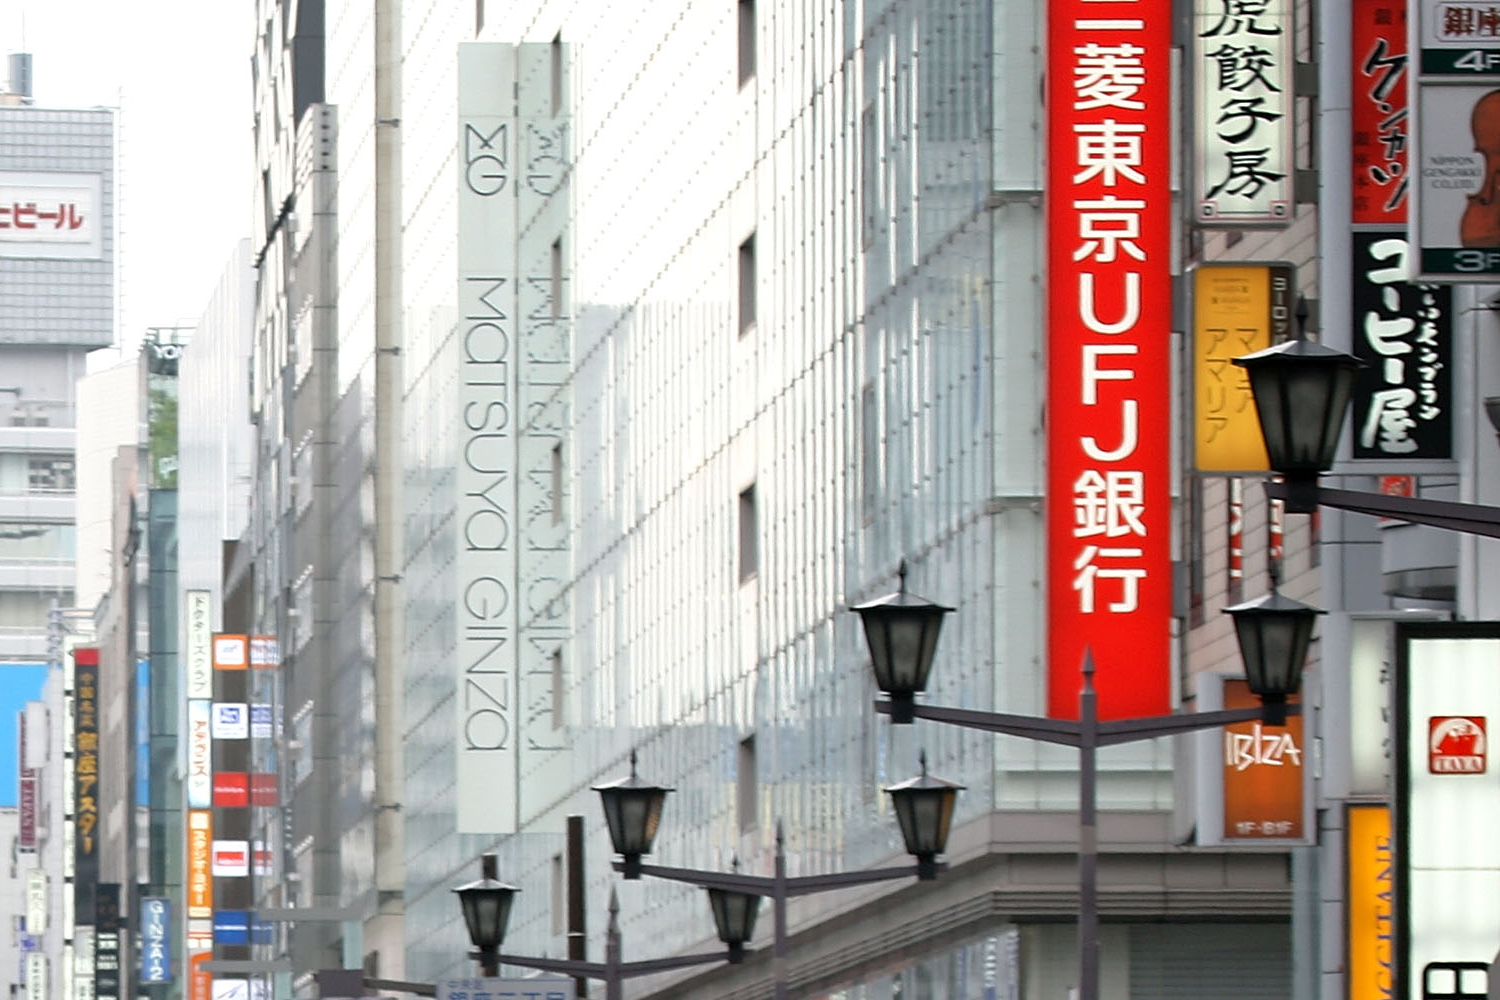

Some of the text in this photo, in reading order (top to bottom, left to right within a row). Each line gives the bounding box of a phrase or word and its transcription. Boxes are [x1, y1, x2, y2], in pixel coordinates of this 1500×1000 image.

[1360, 238, 1419, 454] コーヒー屋
[76, 731, 100, 854] 銀座アスター
[1225, 724, 1302, 772] IBIZA
